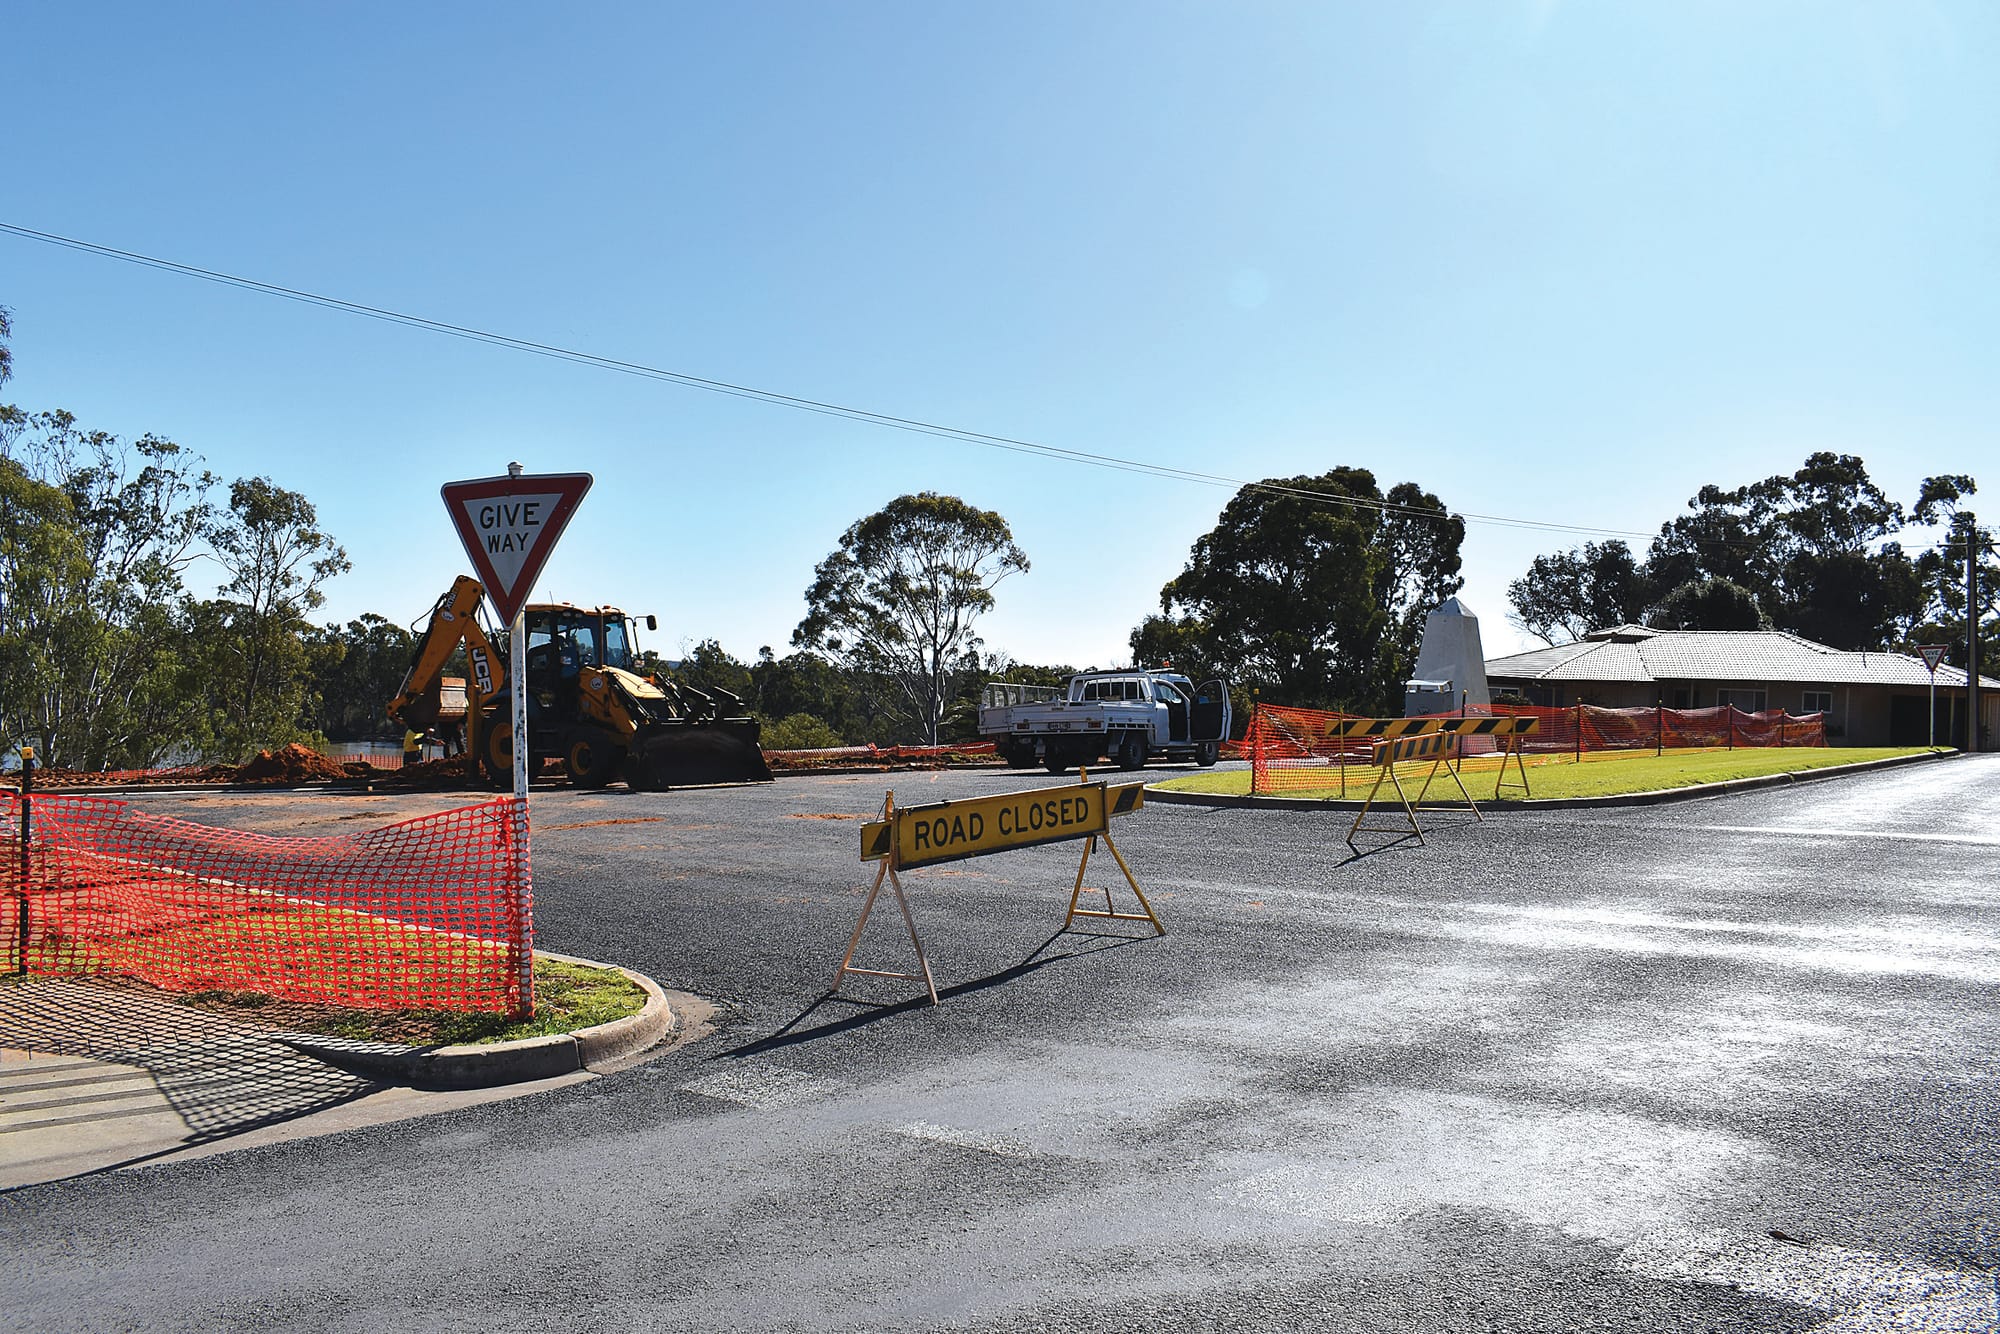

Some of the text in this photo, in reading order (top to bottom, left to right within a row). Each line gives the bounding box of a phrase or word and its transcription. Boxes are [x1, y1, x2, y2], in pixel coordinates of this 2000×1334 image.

[480, 503, 540, 529] GIVE
[488, 533, 529, 553] WAY
[914, 797, 1089, 850] ROAD CLOSED
